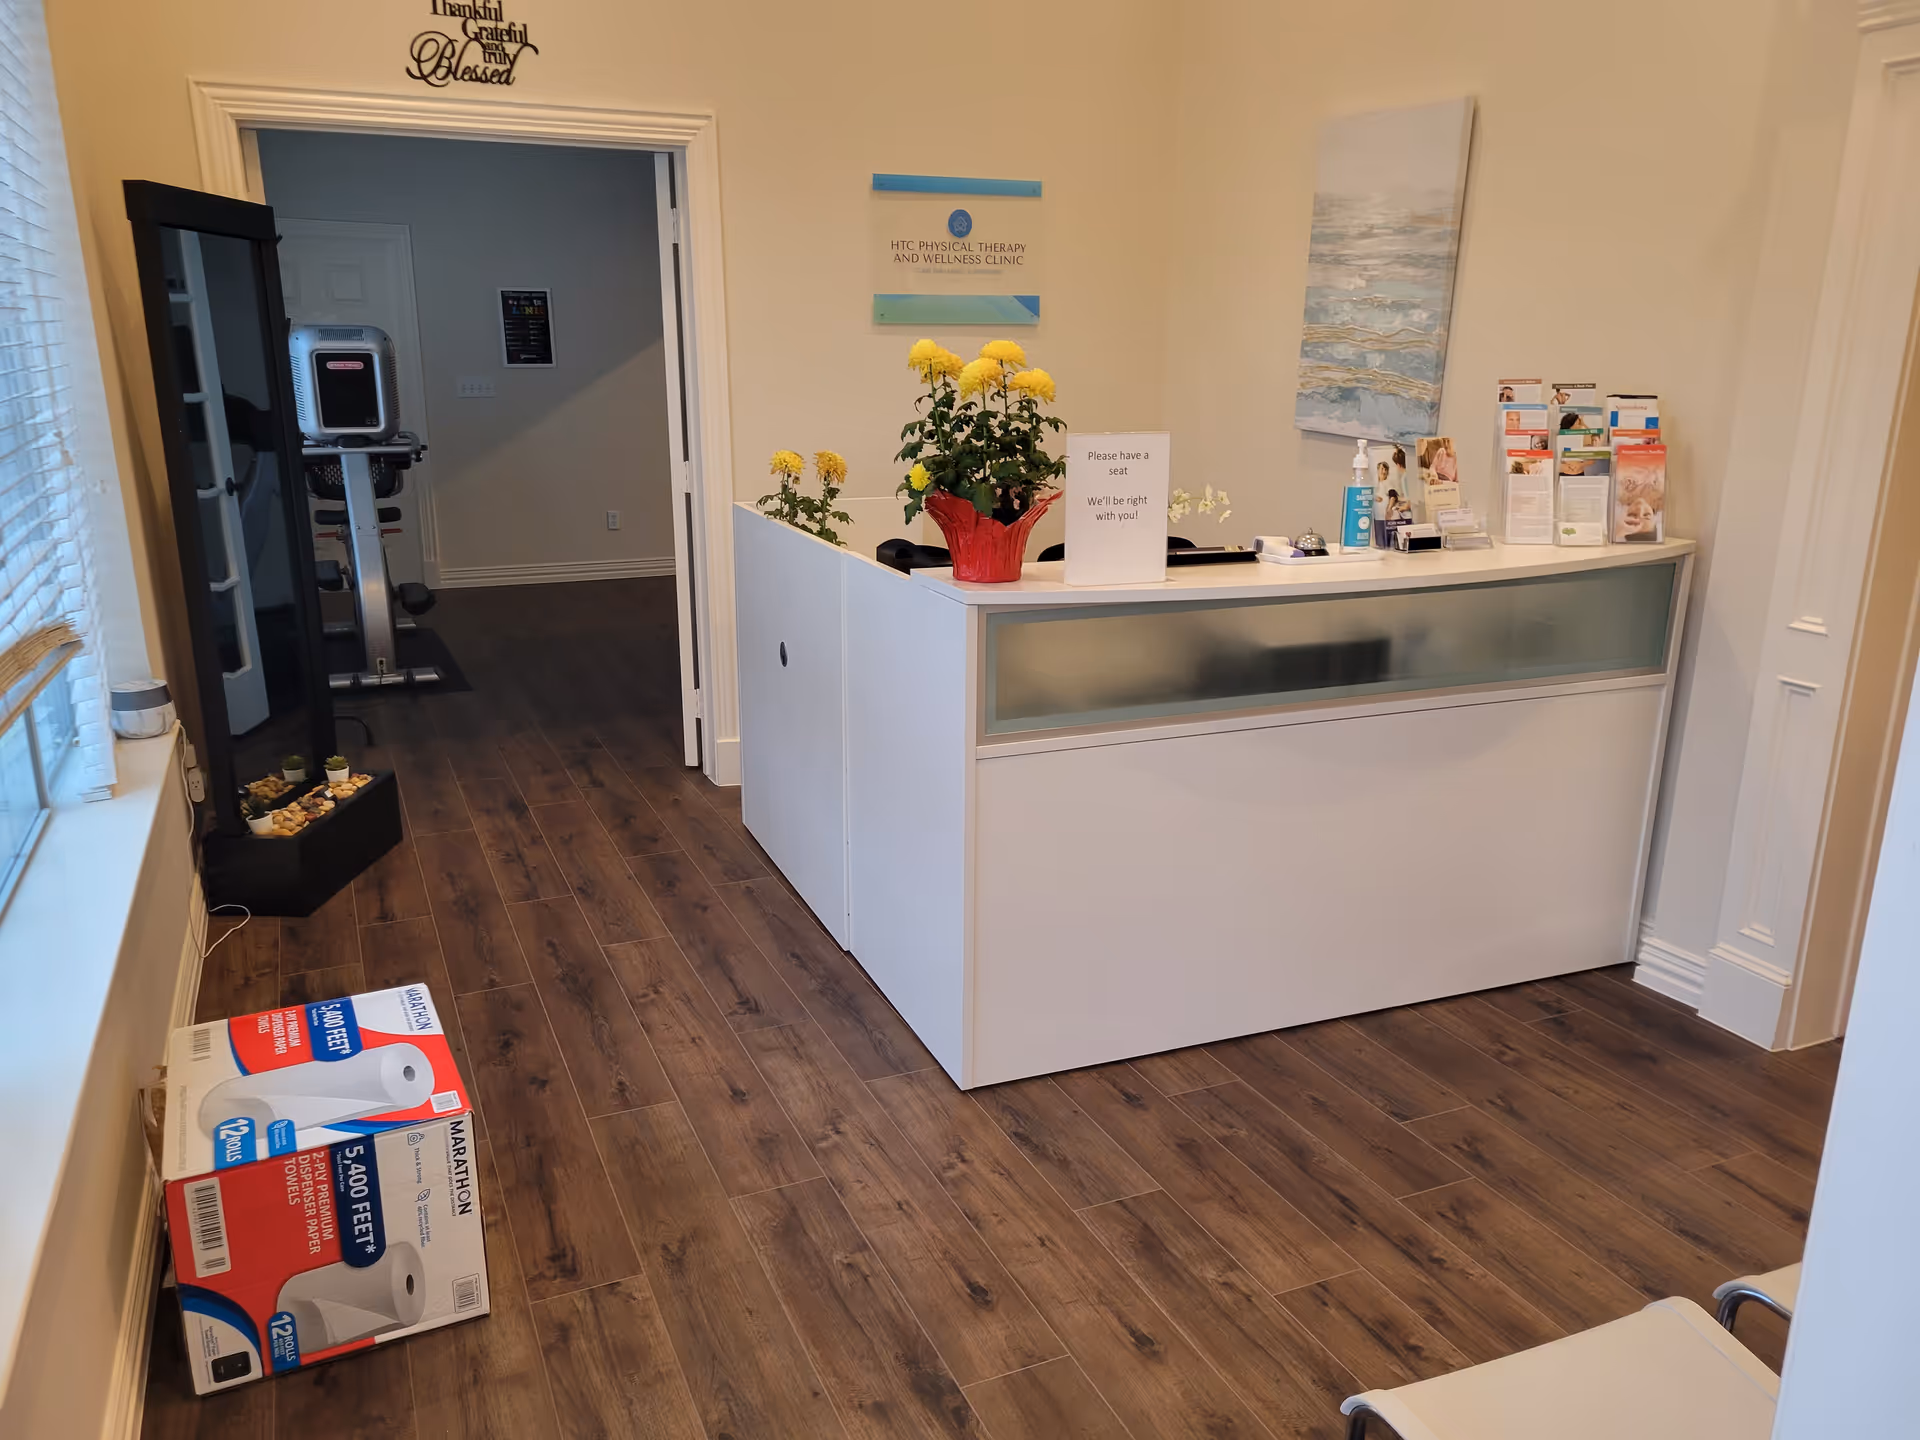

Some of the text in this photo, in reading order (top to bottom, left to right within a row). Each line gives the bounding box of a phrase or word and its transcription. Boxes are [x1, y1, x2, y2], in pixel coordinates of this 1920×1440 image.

[430, 0, 504, 22] Thankful
[461, 17, 529, 44] Grateful
[482, 49, 519, 65] truly
[484, 41, 505, 52] and
[405, 31, 539, 88] Blessed
[891, 240, 1027, 253] HTC PHYSICAL THERAPY
[893, 253, 1024, 265] AND WELLNESS CLINIC
[1088, 451, 1149, 461] Please have a
[1108, 467, 1128, 476] seat
[1087, 495, 1148, 507] We'll be right
[1096, 510, 1139, 522] with you!
[318, 1003, 345, 1028] 5,400
[405, 987, 433, 1031] MARATHON
[257, 1014, 270, 1034] TOWELS
[273, 1037, 288, 1055] PAPER
[220, 1118, 250, 1162] 12 ROLLS
[342, 1145, 369, 1199] 5,400
[449, 1119, 473, 1216] MARATHON
[284, 1157, 301, 1206] TOWELS
[299, 1154, 322, 1255] DISPENSER PAPER
[313, 1151, 334, 1241] 2-PLY PREMIUM
[271, 1314, 297, 1362] 12 ROLLS
